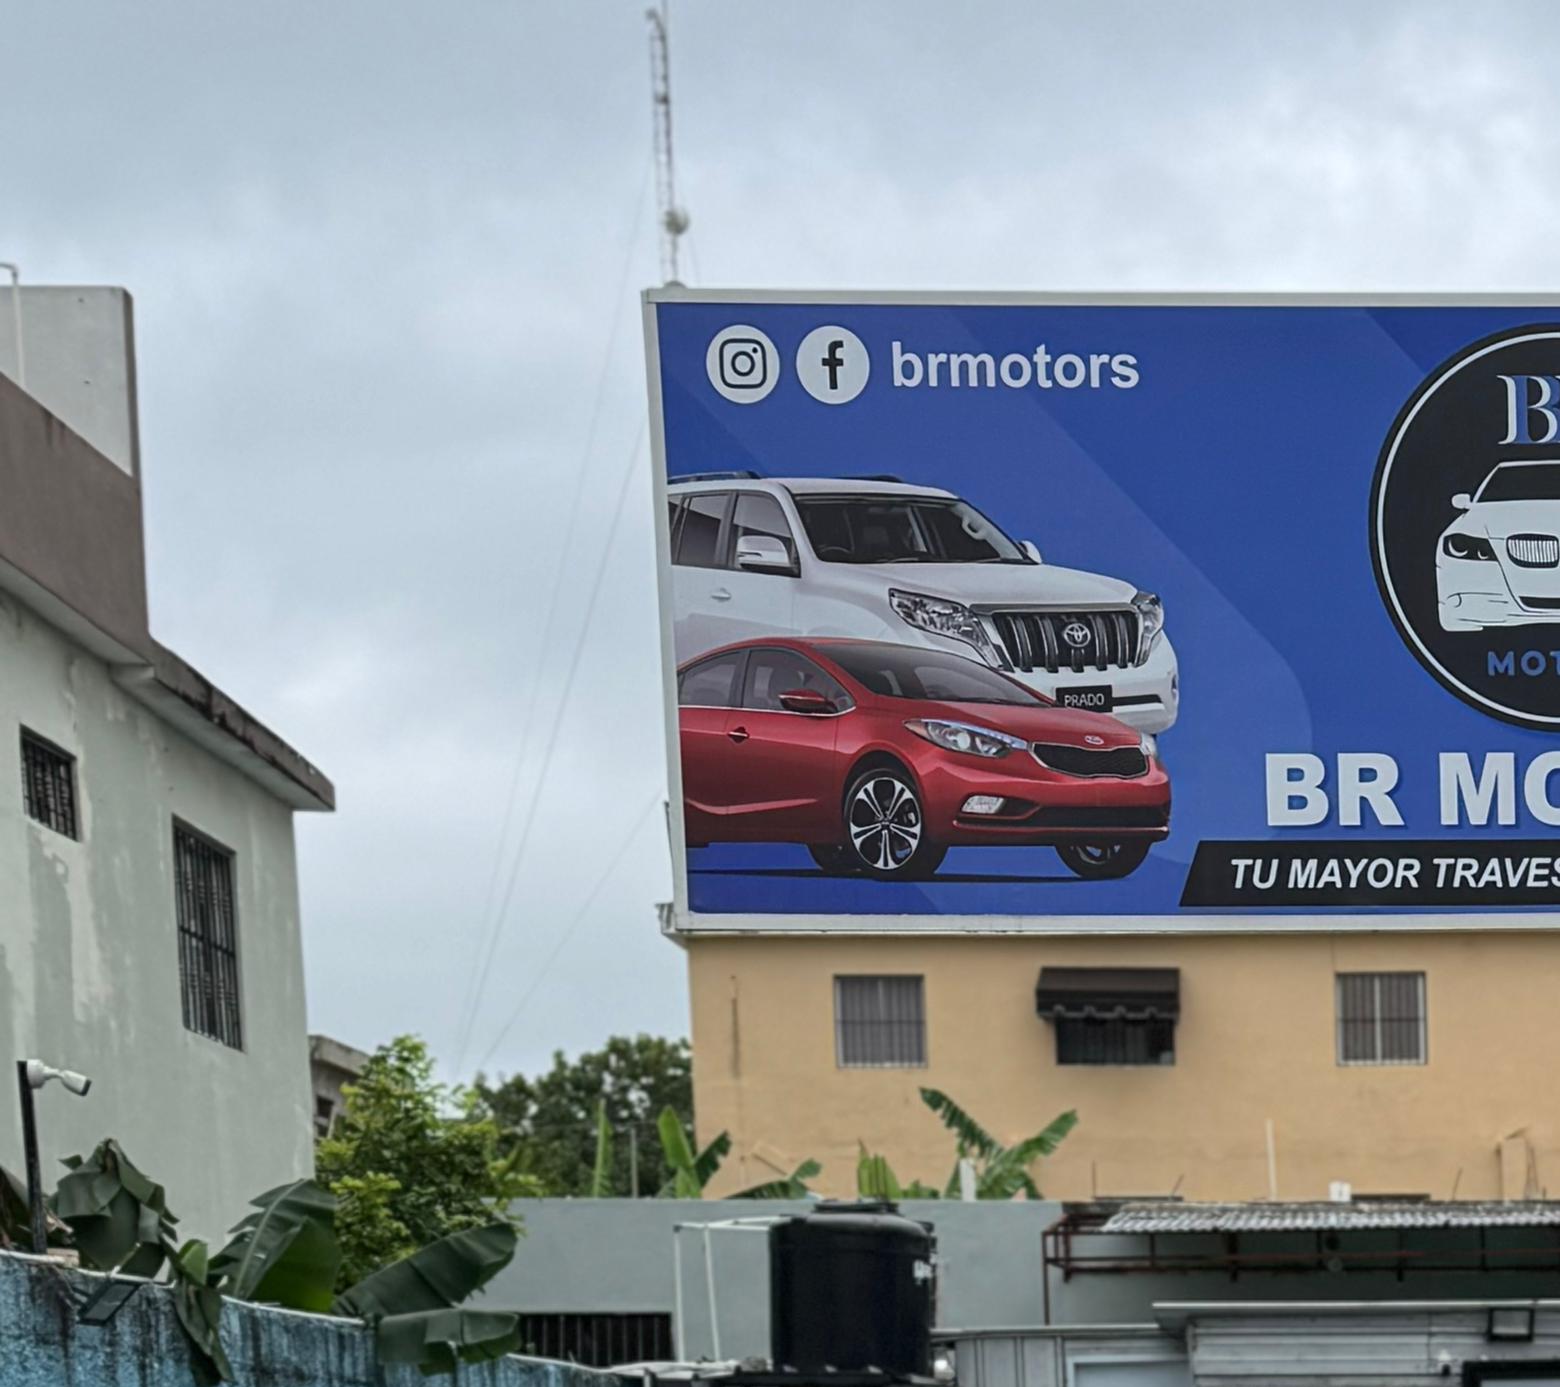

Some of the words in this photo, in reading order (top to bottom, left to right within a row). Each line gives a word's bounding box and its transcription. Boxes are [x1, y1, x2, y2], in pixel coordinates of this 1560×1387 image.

[892, 341, 1140, 389] brmotors
[1064, 693, 1105, 707] PRADO
[1265, 751, 1402, 828] BR
[1231, 858, 1279, 890] TU
[1288, 857, 1420, 889] MAYOR
